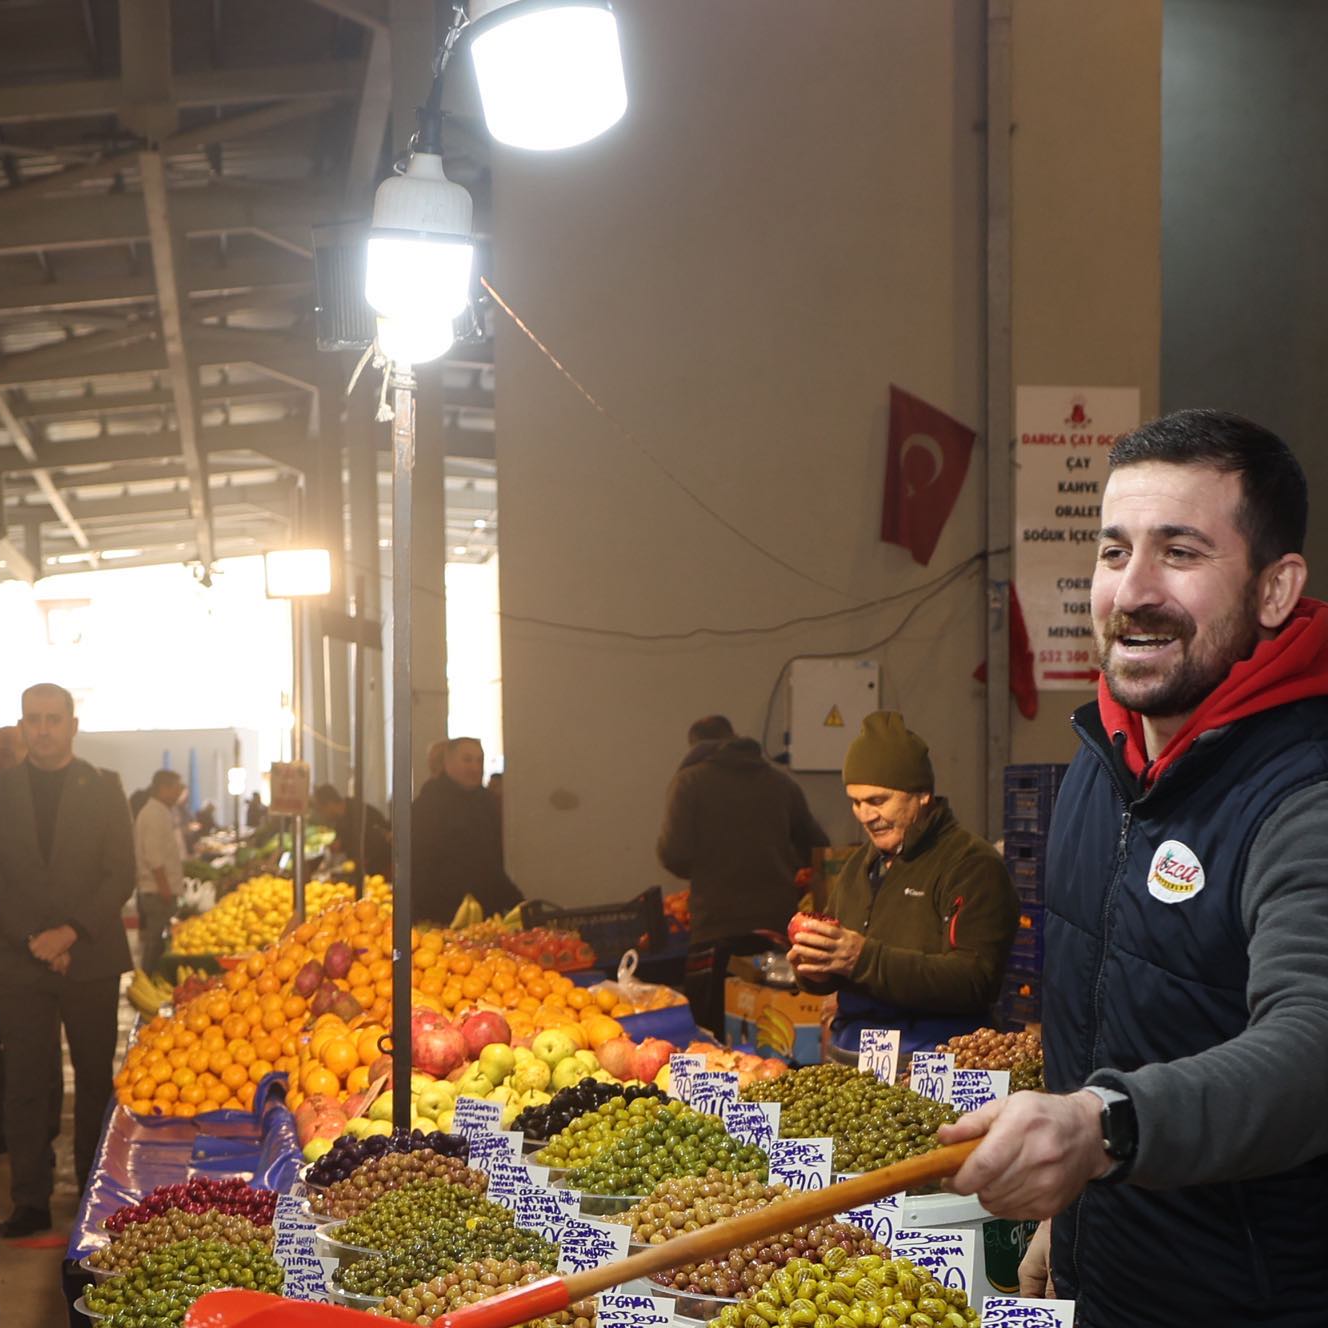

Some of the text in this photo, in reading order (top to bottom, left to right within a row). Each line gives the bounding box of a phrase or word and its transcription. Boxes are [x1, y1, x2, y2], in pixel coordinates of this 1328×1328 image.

[1022, 434, 1093, 448] DARICA ÇAY
[1066, 457, 1091, 471] ÇAY
[1058, 481, 1099, 492] KAHVE
[1055, 505, 1102, 517] ORALET
[1023, 526, 1065, 541] SOĞUK
